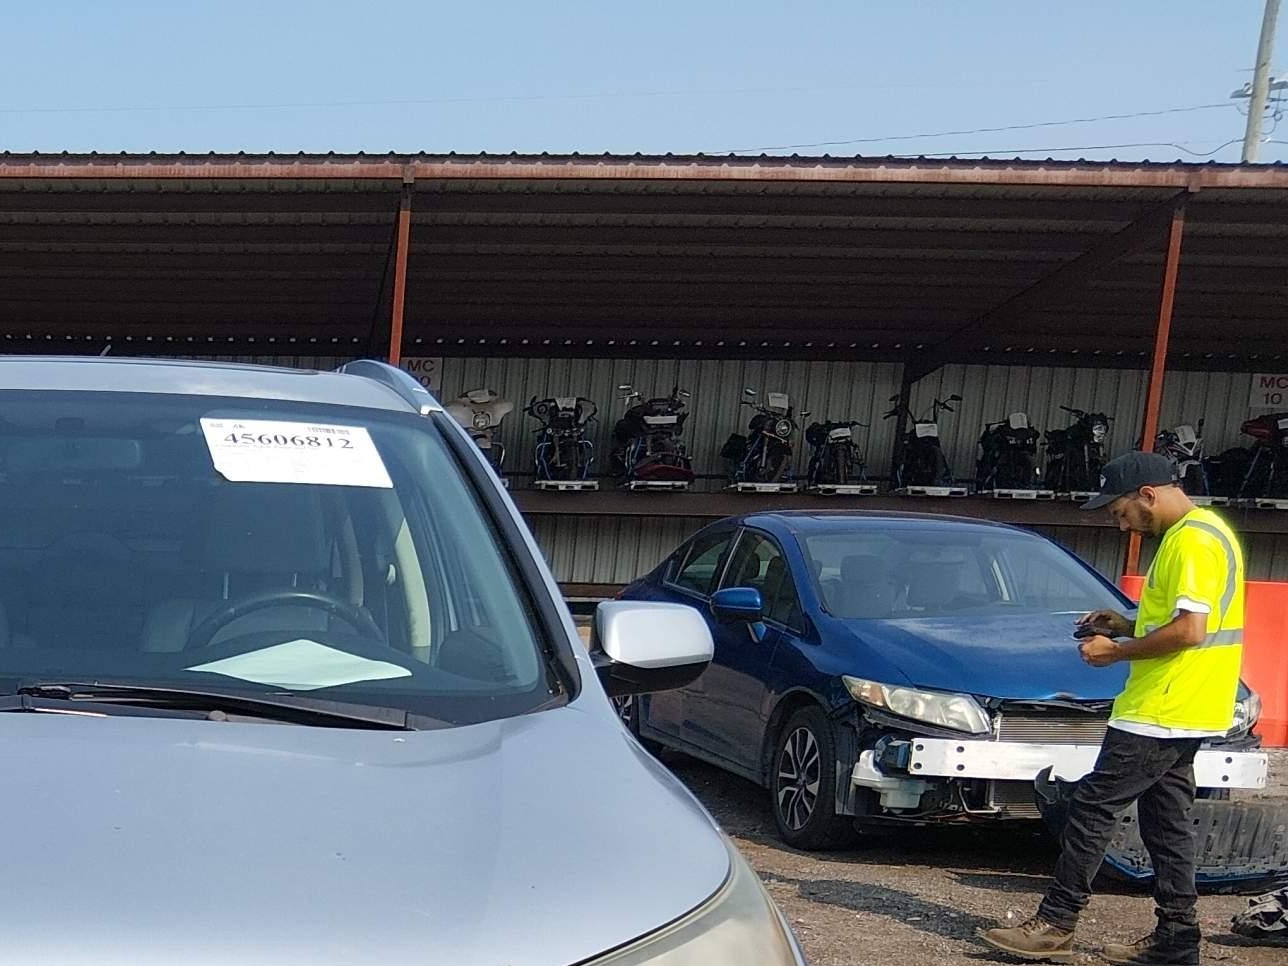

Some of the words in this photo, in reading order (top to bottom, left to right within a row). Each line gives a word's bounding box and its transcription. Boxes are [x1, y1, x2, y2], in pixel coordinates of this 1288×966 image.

[407, 359, 434, 372] MC
[1260, 376, 1288, 389] MC
[1264, 393, 1282, 405] 10
[223, 432, 354, 450] 45606812
